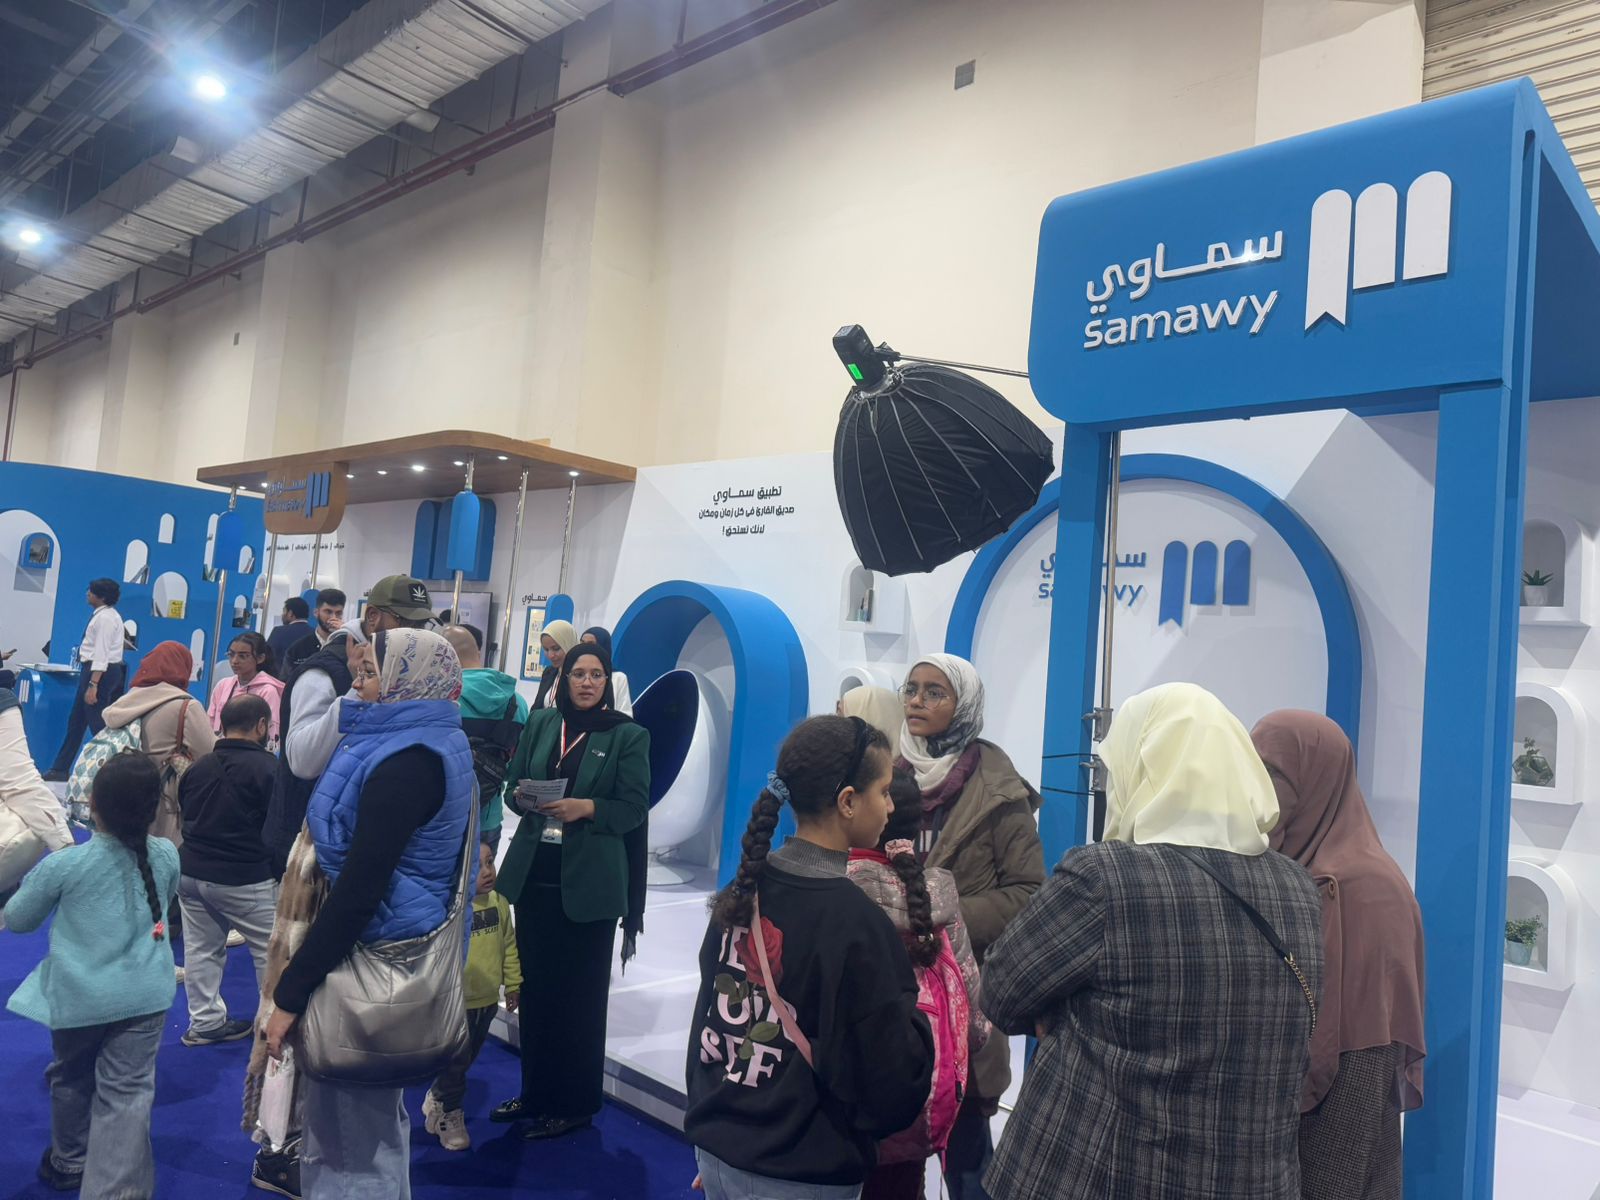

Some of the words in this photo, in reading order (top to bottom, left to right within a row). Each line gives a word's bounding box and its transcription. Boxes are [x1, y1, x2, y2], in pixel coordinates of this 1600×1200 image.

[1086, 230, 1284, 315] سماوي
[1084, 290, 1279, 350] samawy
[713, 487, 754, 505] سماوي
[757, 486, 781, 499] تطبيق
[698, 509, 719, 520] ومكان
[719, 508, 734, 519] زمان
[734, 507, 745, 519] كل
[776, 505, 794, 515] صديق
